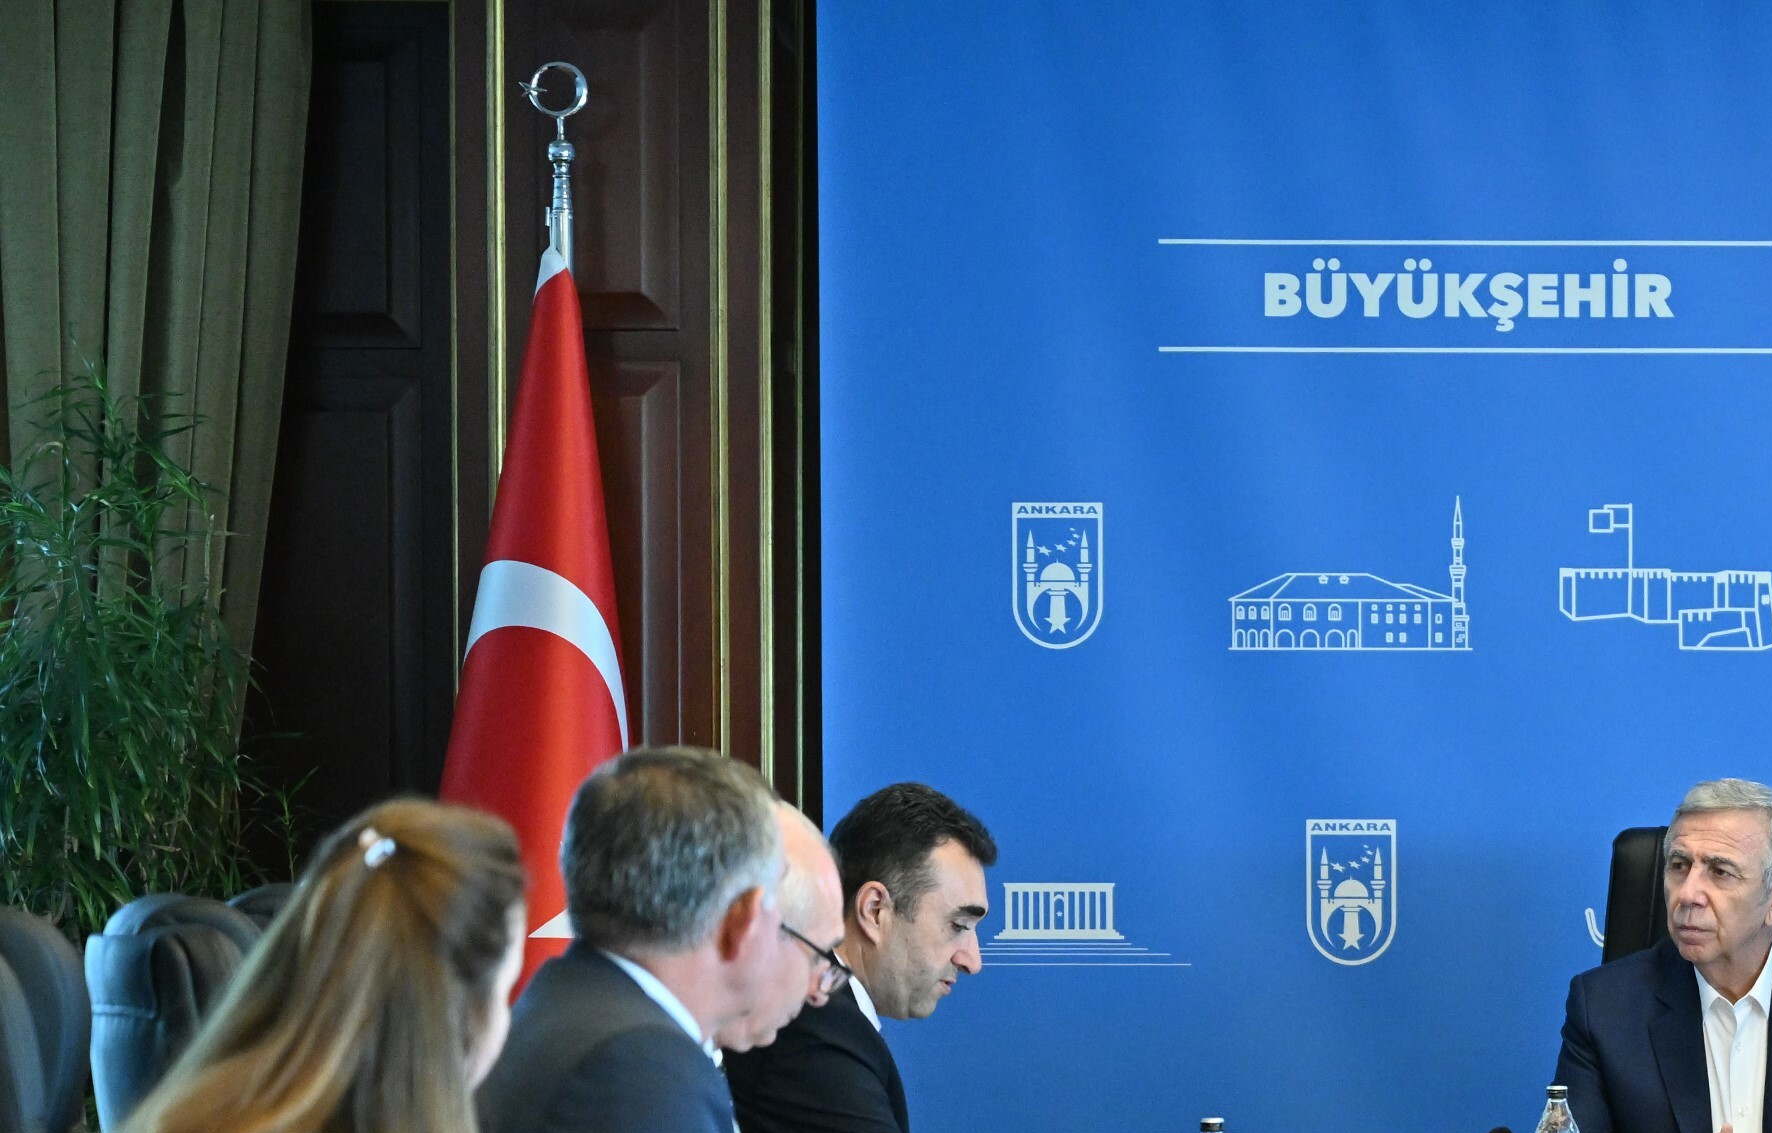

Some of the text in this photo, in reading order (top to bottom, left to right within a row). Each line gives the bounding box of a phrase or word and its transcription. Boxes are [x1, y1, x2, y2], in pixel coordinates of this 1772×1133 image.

[1263, 257, 1675, 333] BÜYÜKŞEHİR
[1016, 505, 1099, 515] ANKARA
[1310, 822, 1392, 832] ANKARA
